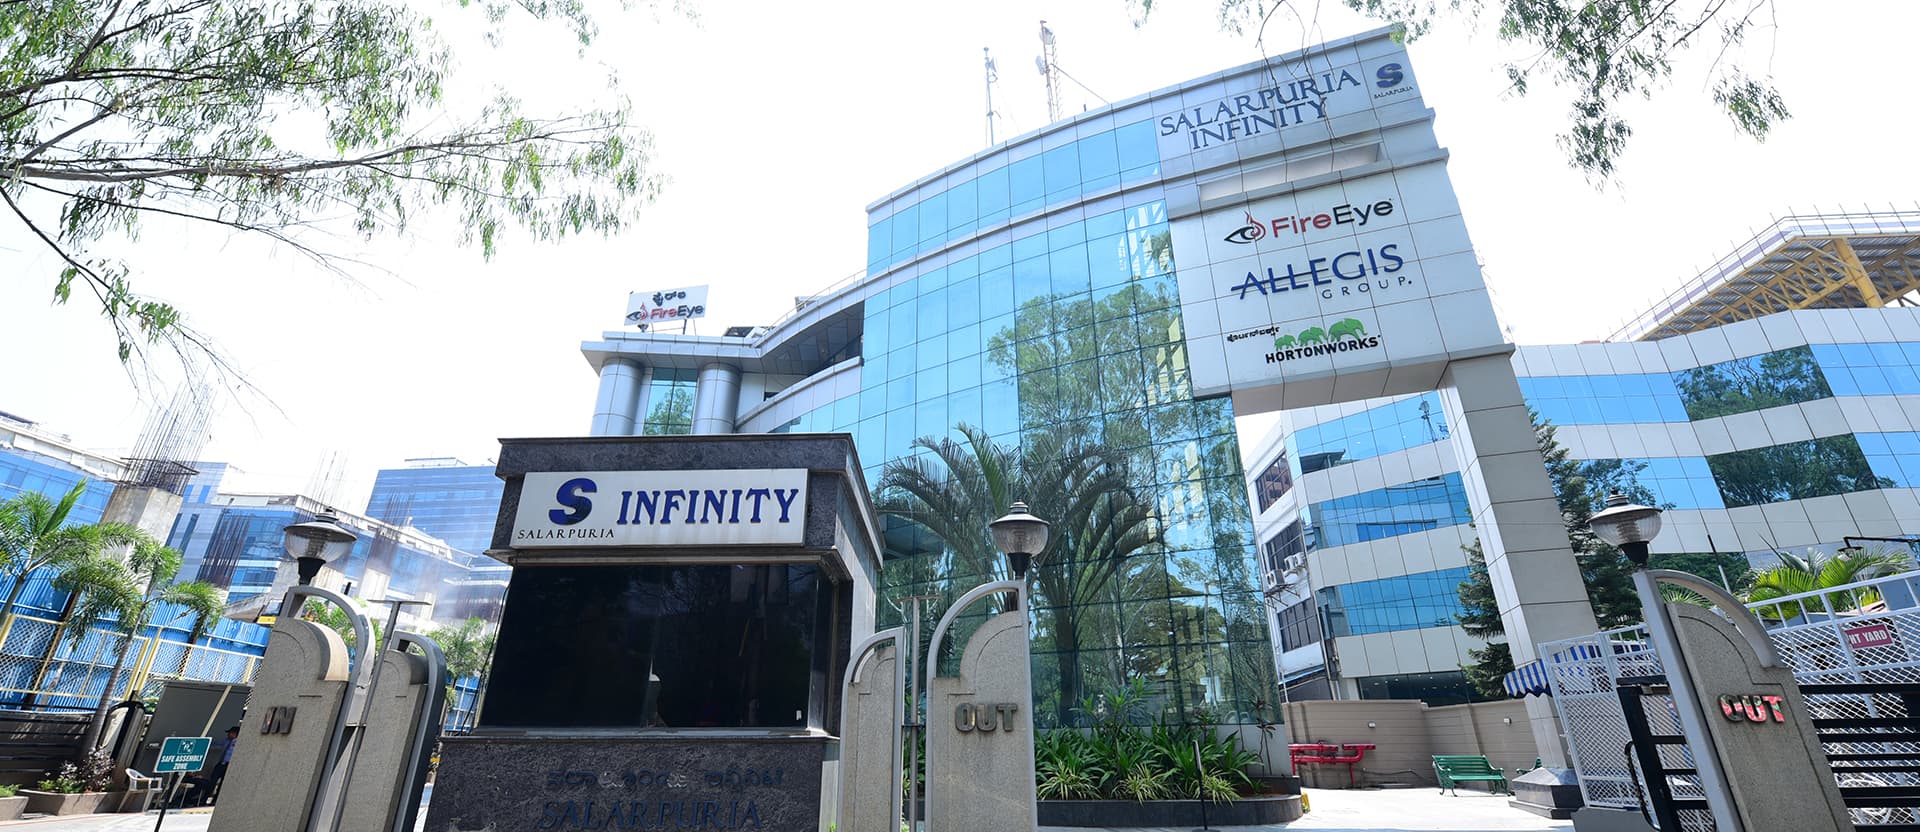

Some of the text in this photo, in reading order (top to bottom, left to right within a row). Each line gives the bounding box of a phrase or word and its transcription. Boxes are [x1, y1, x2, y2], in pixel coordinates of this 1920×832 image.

[1160, 69, 1360, 136] SALARPURIA
[1374, 86, 1413, 98] SALARPURIA
[1191, 97, 1327, 149] INFINITY
[1271, 200, 1393, 238] FireEye
[1231, 244, 1403, 300] ALLEGIS
[650, 305, 704, 320] FireEye
[1265, 336, 1379, 364] HORTONWORKS
[616, 488, 799, 525] INFINITY
[517, 528, 615, 540] SALARPURIA
[1862, 630, 1888, 642] YARD
[261, 706, 297, 735] IN
[954, 702, 1018, 733] OUT
[1720, 694, 1785, 723] OUT
[160, 755, 176, 763] SAFE
[537, 799, 762, 829] SALARPURIA
